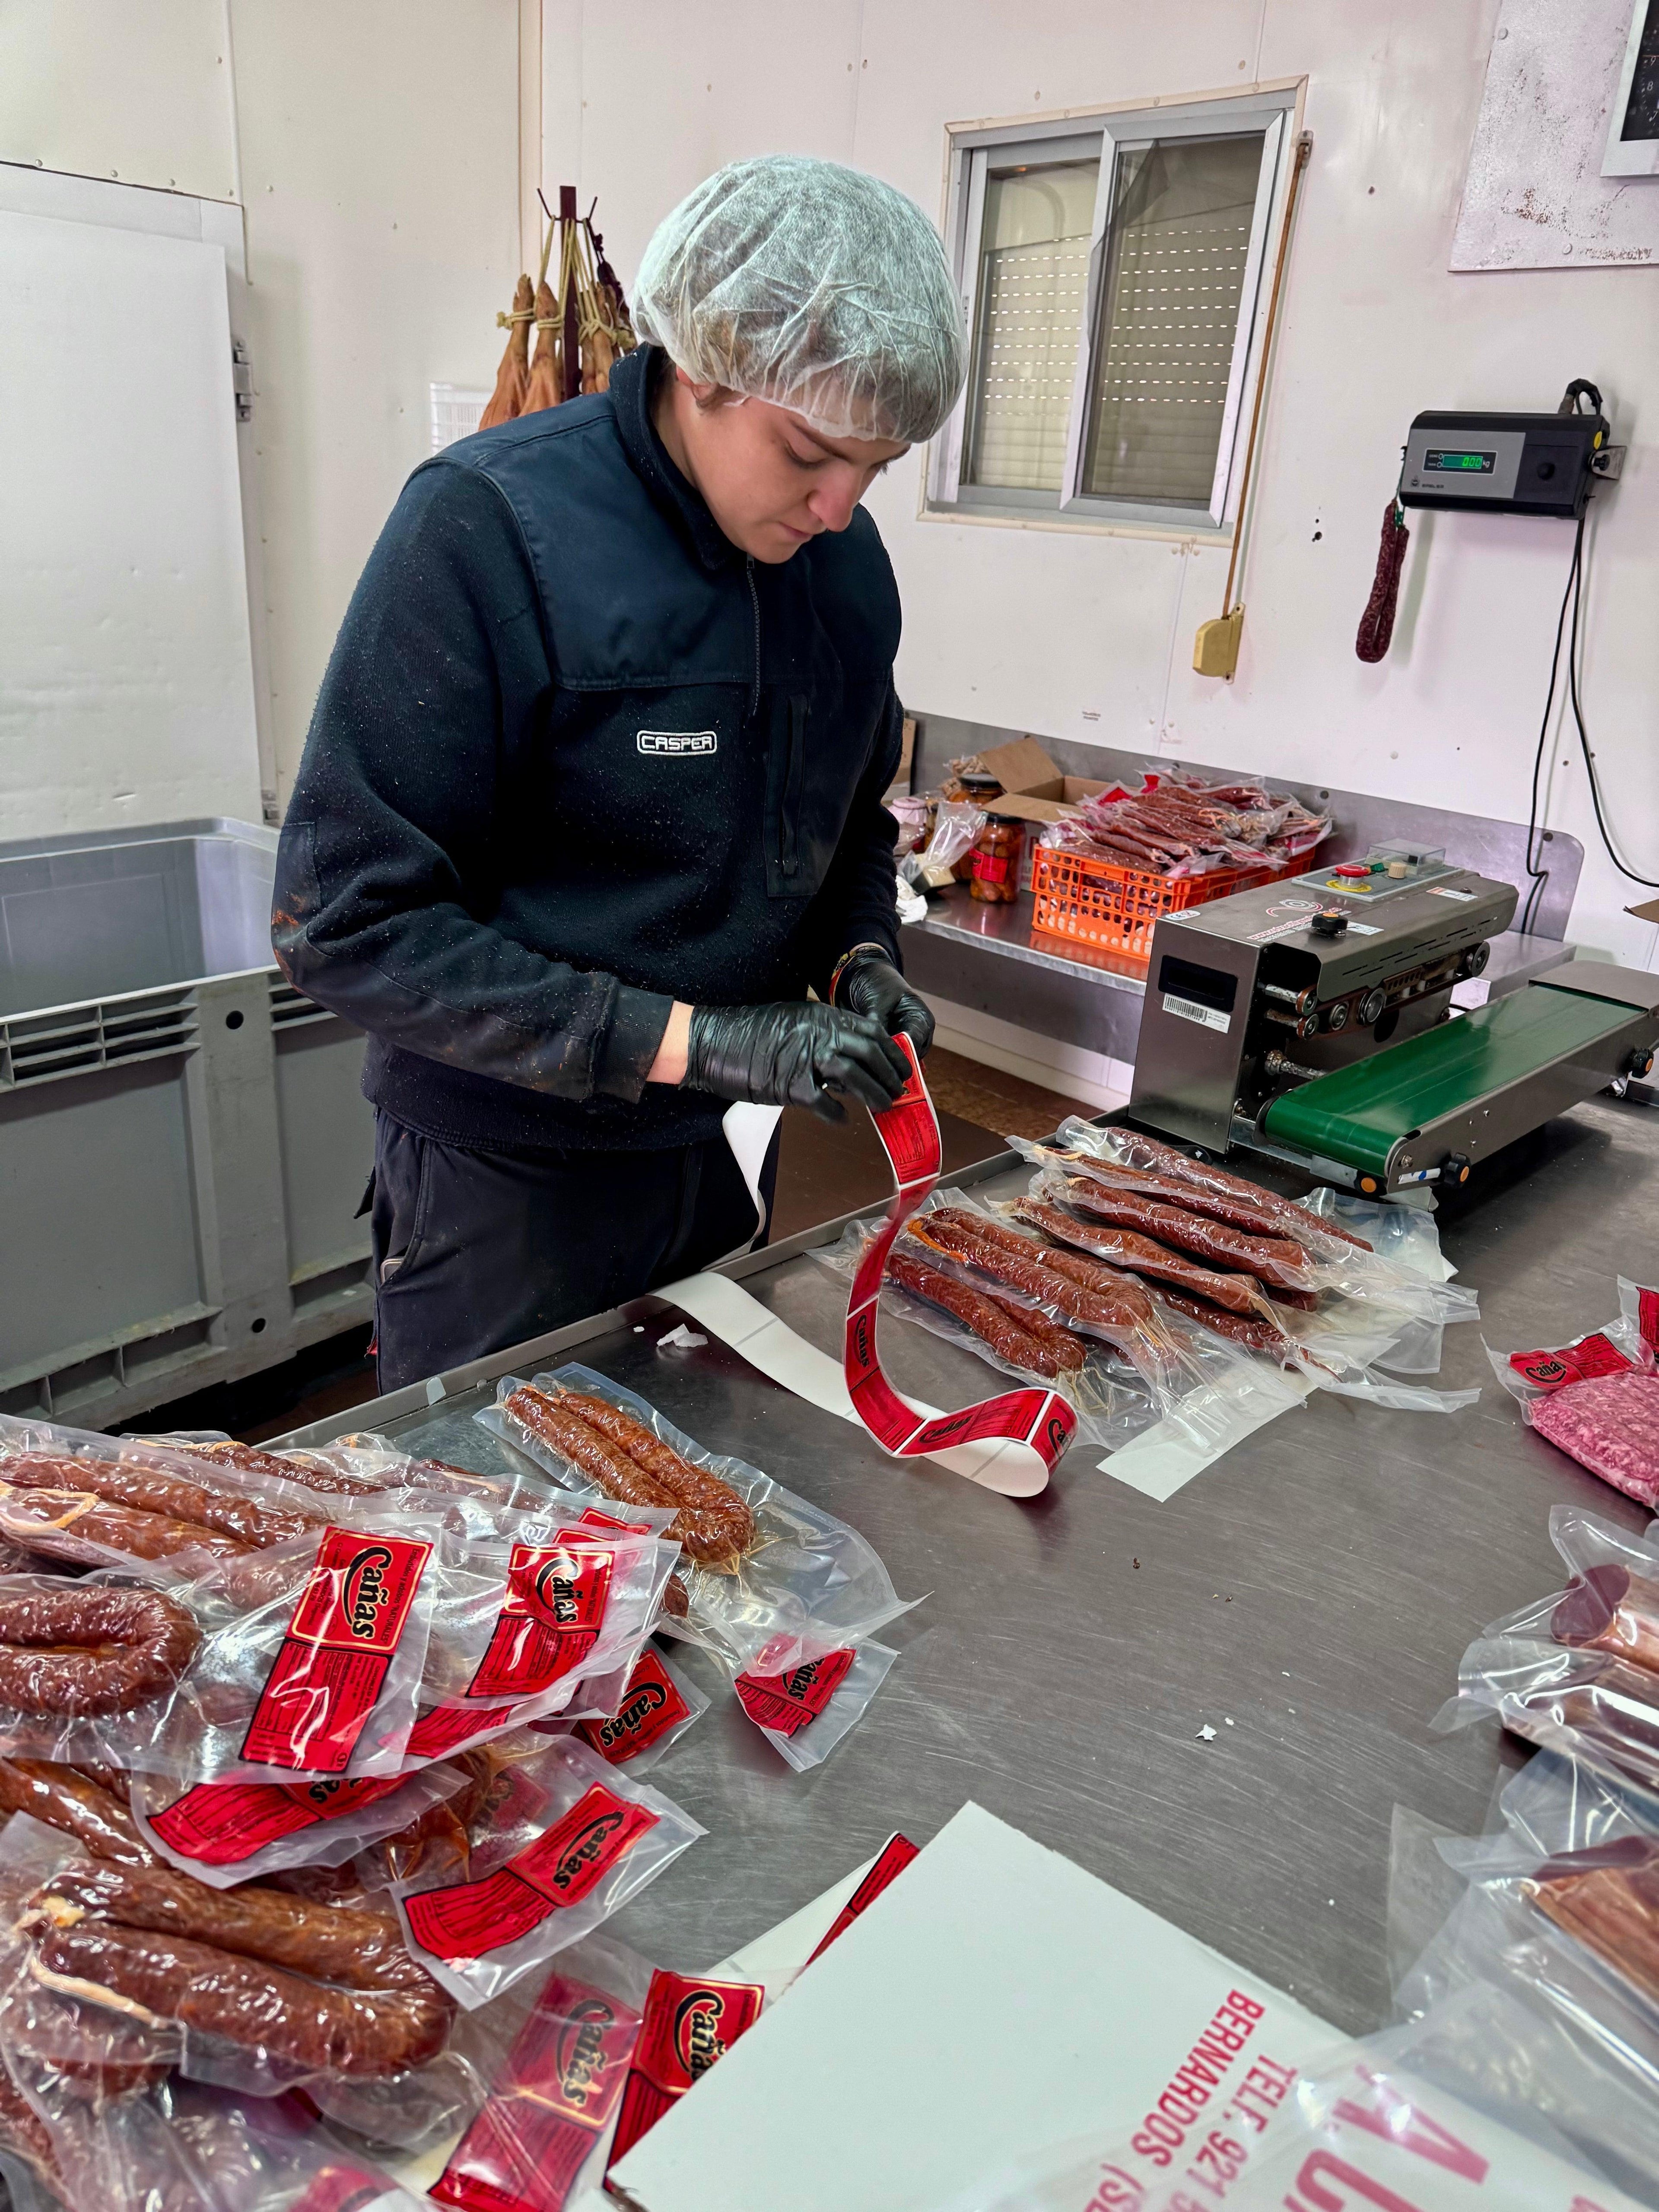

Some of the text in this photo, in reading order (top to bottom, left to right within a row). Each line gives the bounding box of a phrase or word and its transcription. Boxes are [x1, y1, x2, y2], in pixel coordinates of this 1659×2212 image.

[1647, 81, 1653, 91] 8
[641, 735, 712, 751] CASPER
[343, 1546, 393, 1639] Cañas
[536, 1557, 582, 1623] Cañas
[603, 1681, 668, 1747] Cañas
[553, 1811, 625, 1890] Cañas
[557, 2000, 614, 2107] Cañas
[1131, 1989, 1266, 2168] BERNARDOS
